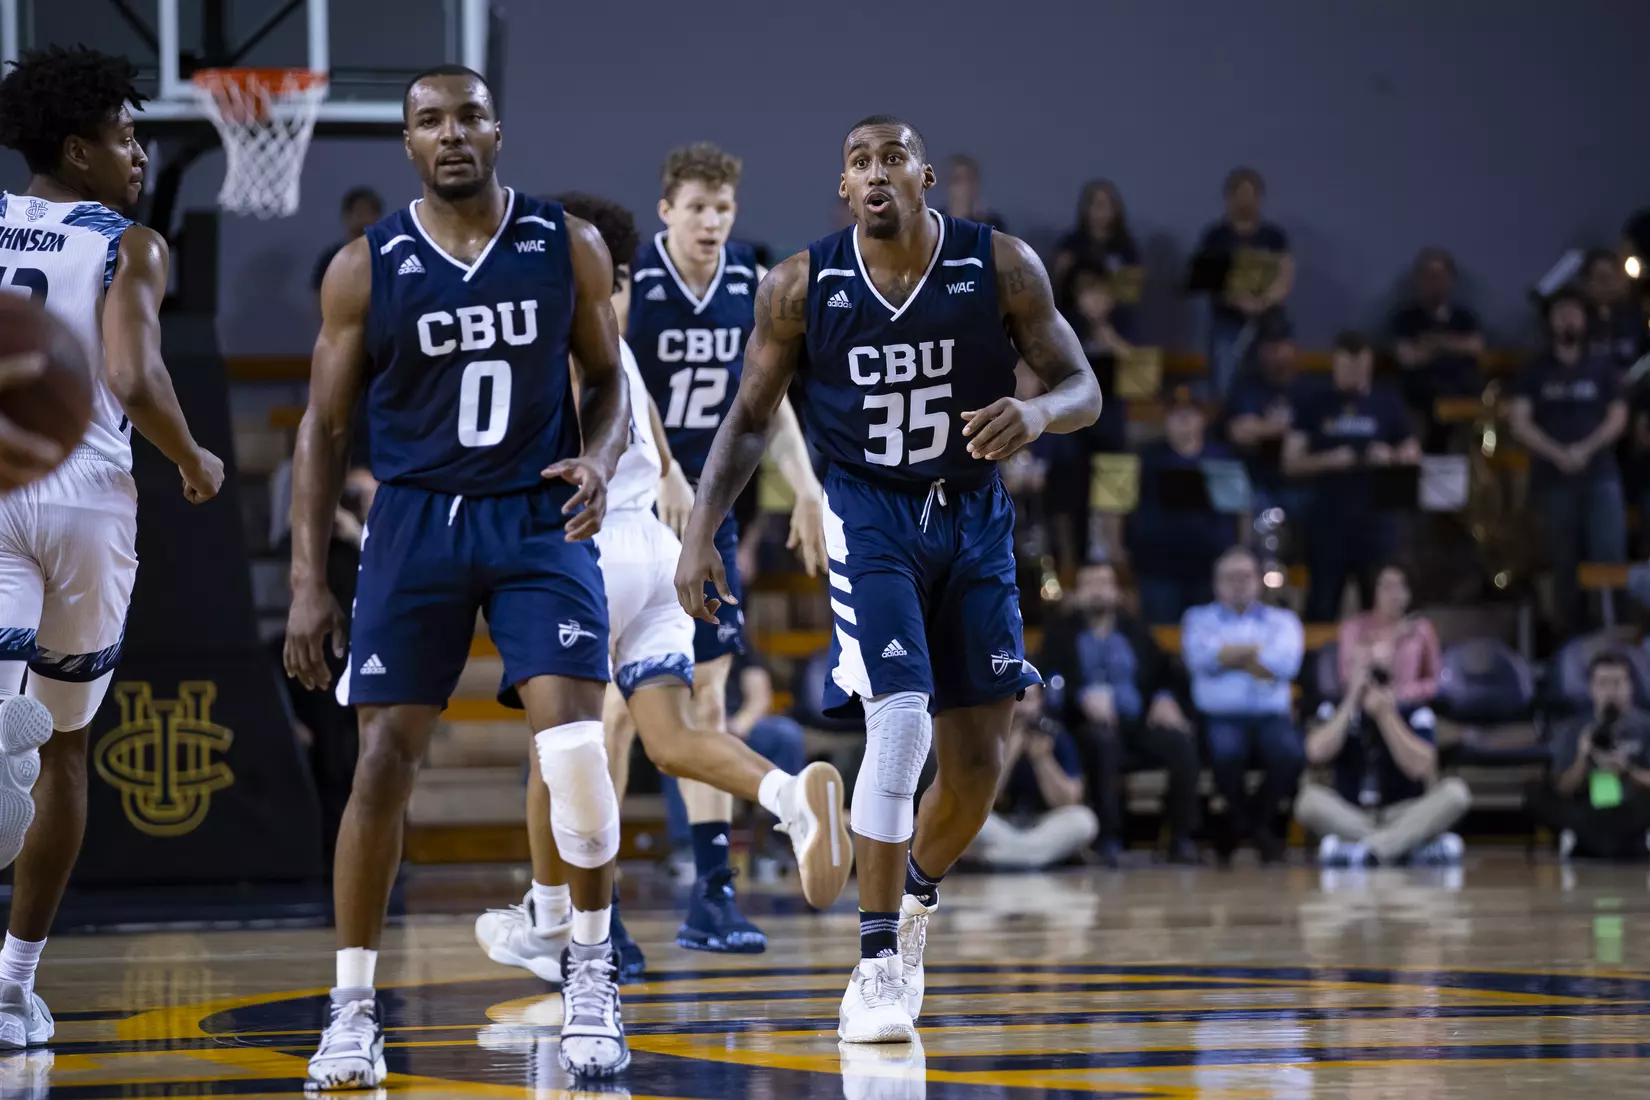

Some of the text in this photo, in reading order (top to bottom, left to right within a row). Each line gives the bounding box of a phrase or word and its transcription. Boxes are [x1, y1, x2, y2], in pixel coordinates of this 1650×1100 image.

[515, 240, 546, 252] WAC
[398, 266, 426, 275] adidas
[946, 281, 975, 295] WAC
[827, 300, 852, 309] adidas
[417, 300, 538, 357] CBU
[657, 327, 741, 362] CBU
[848, 339, 955, 386] CBU
[458, 360, 512, 448] 0
[664, 367, 729, 429] 12
[862, 383, 952, 467] 35
[881, 649, 908, 658] adidas
